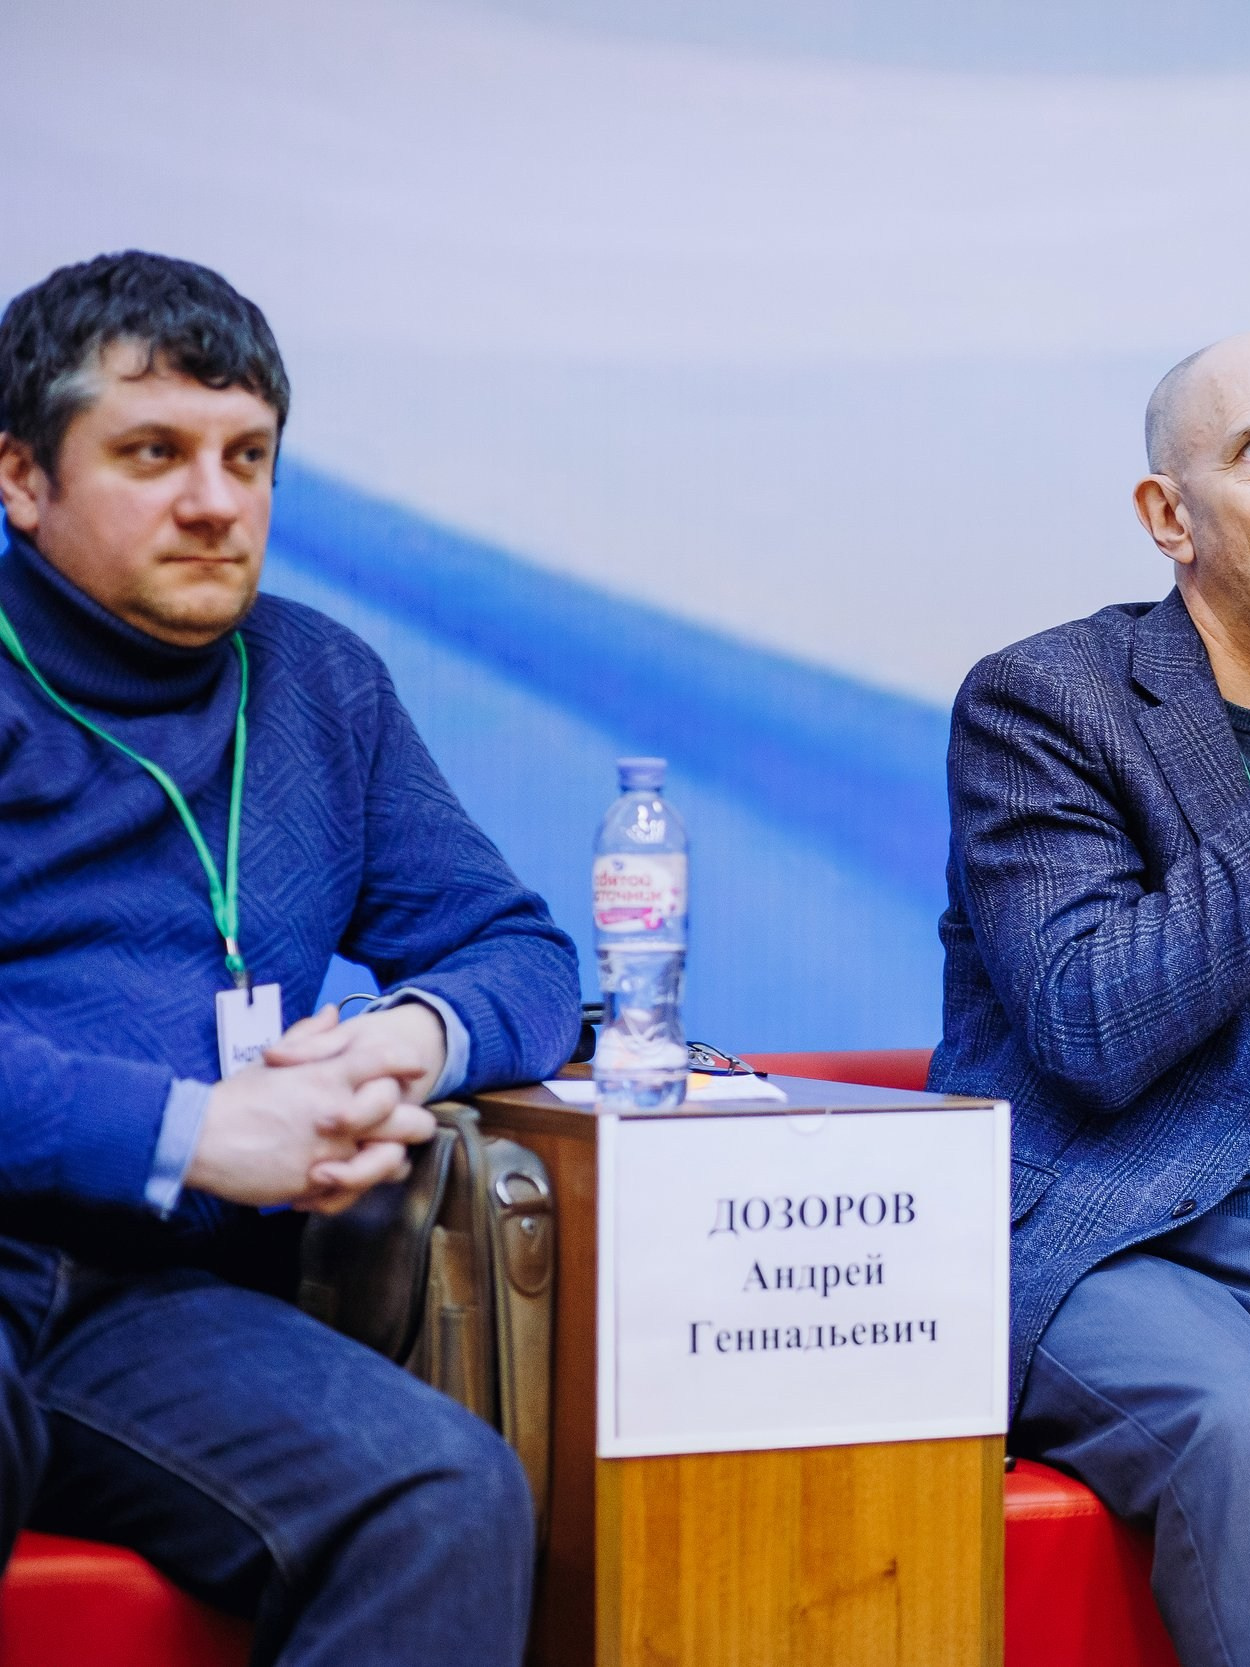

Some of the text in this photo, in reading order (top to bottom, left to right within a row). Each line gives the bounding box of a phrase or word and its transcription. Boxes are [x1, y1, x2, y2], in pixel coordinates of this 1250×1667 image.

[708, 1191, 917, 1240] ДОЗОРОВ
[742, 1253, 886, 1298] Андрей
[687, 1319, 939, 1356] Геннадьевич
